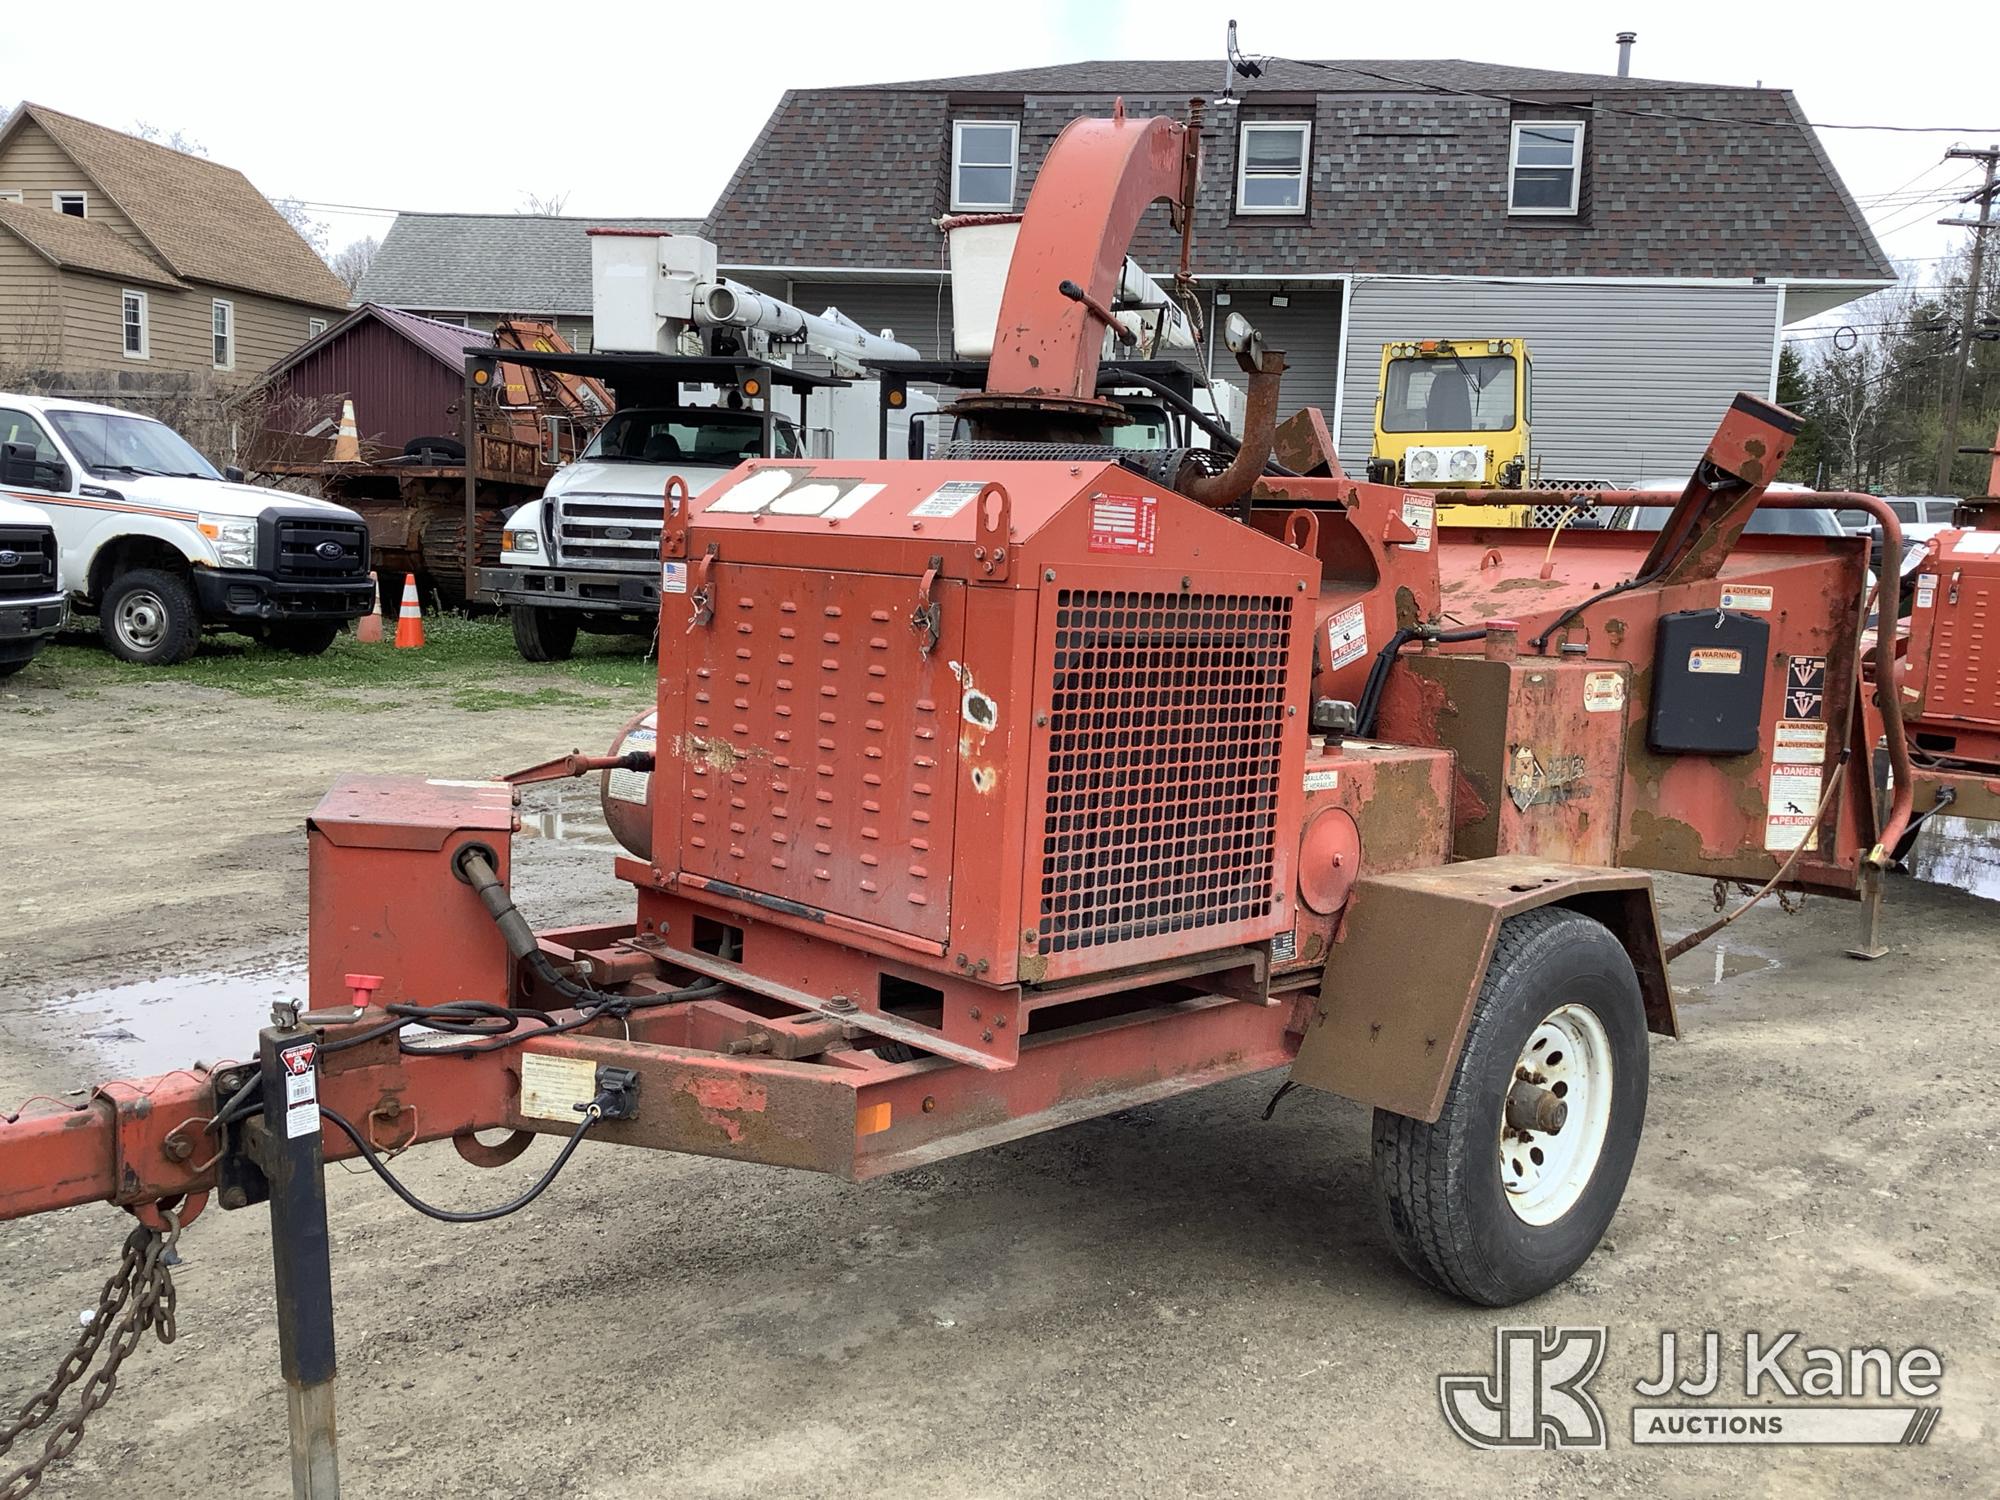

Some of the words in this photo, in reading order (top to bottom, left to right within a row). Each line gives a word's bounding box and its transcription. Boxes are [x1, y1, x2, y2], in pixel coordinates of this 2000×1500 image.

[1336, 605, 1362, 624] DANGER
[1339, 636, 1366, 656] PELIGRO
[1701, 651, 1737, 659] WARNING
[1783, 766, 1821, 776] DANGER
[285, 1048, 313, 1059] BULLDOG
